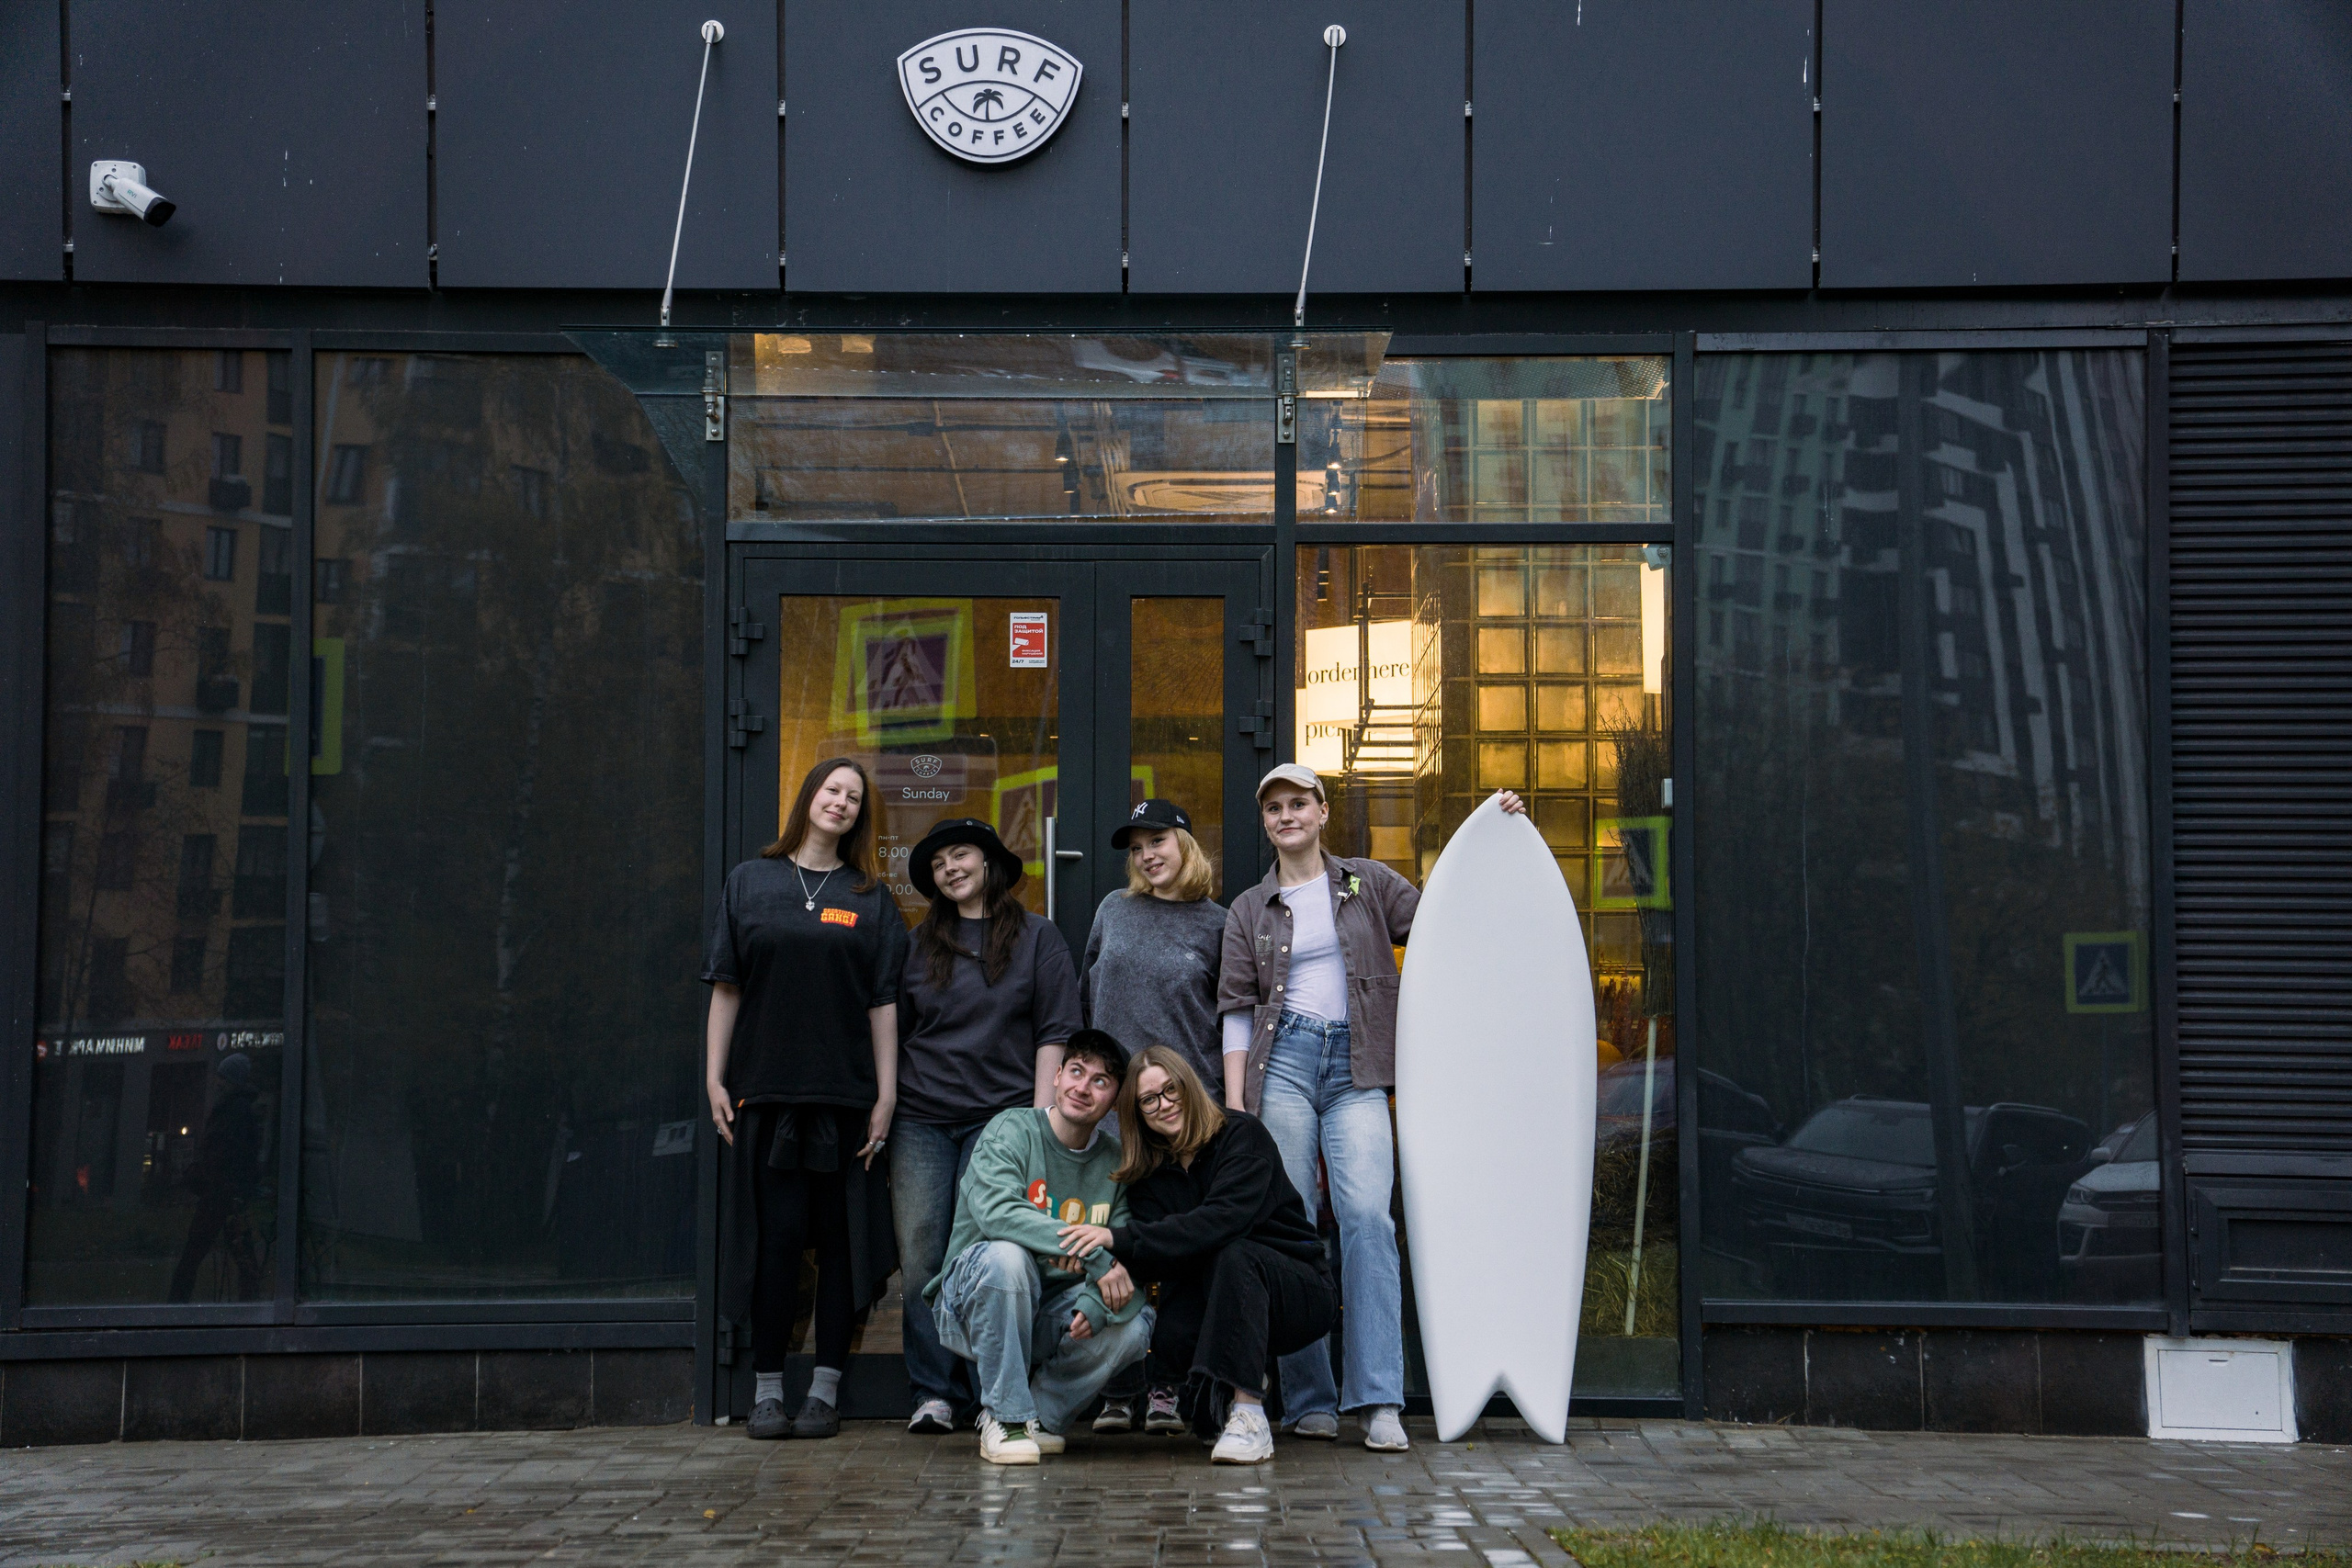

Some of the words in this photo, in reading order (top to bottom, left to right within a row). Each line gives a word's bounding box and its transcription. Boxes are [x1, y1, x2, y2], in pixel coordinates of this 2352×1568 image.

[918, 44, 1061, 85] SURF
[930, 106, 1046, 146] COFFEE
[1307, 661, 1360, 684] order
[902, 786, 950, 802] Sunday
[878, 846, 909, 858] 8.00
[820, 912, 856, 924] GANG!
